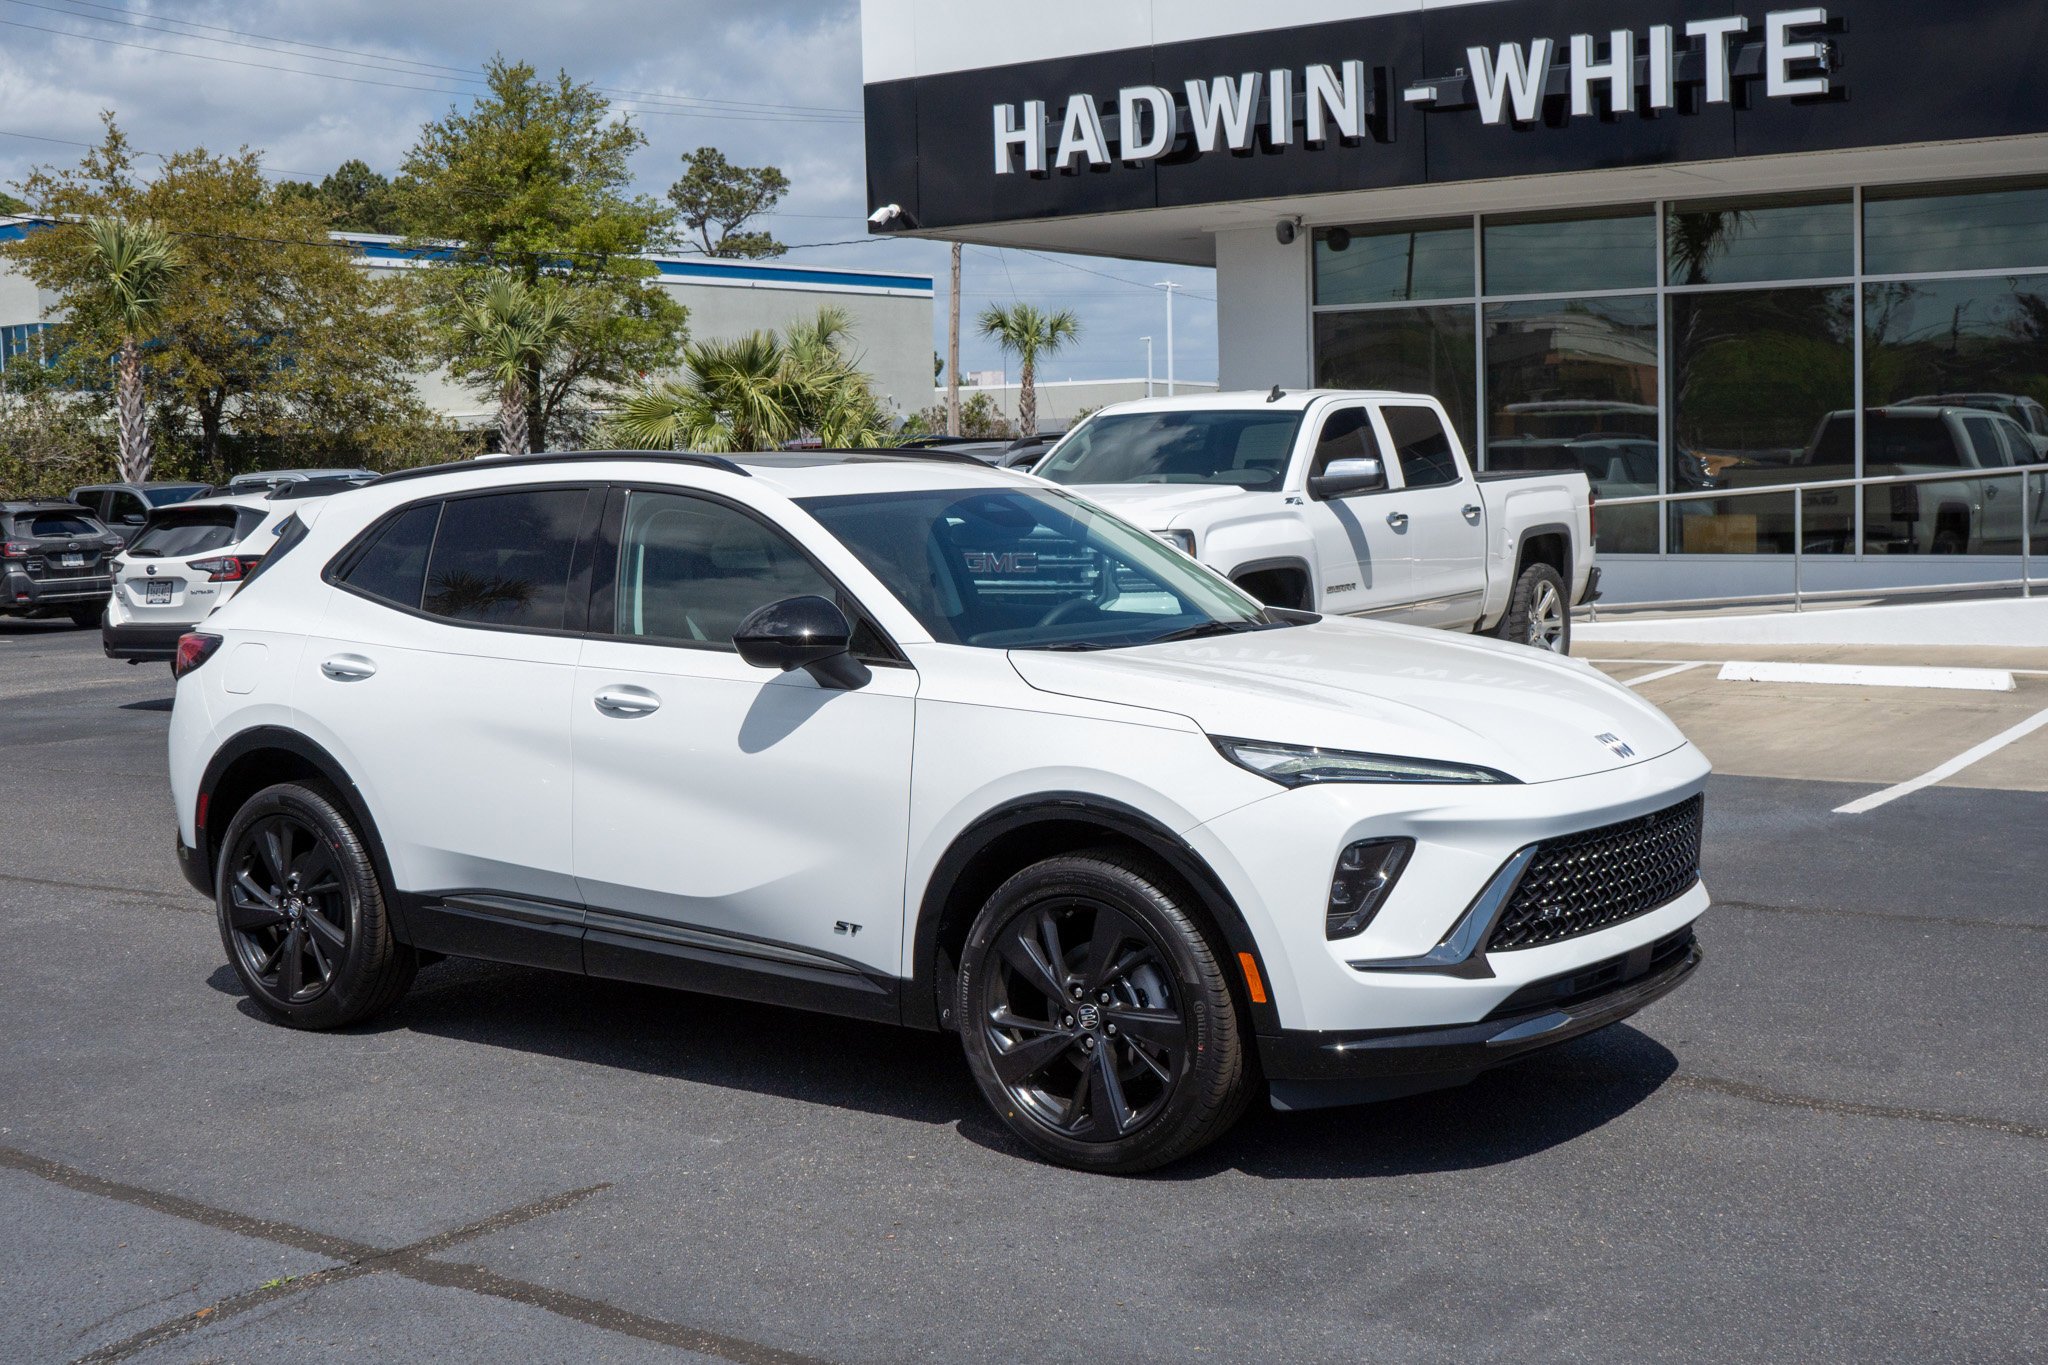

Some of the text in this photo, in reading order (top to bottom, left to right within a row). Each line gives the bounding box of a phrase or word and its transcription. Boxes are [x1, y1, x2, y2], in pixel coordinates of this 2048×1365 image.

[995, 59, 1366, 175] HADWIN
[1466, 8, 1830, 126] WHITE
[963, 552, 1037, 573] GMC
[834, 920, 863, 937] ST
